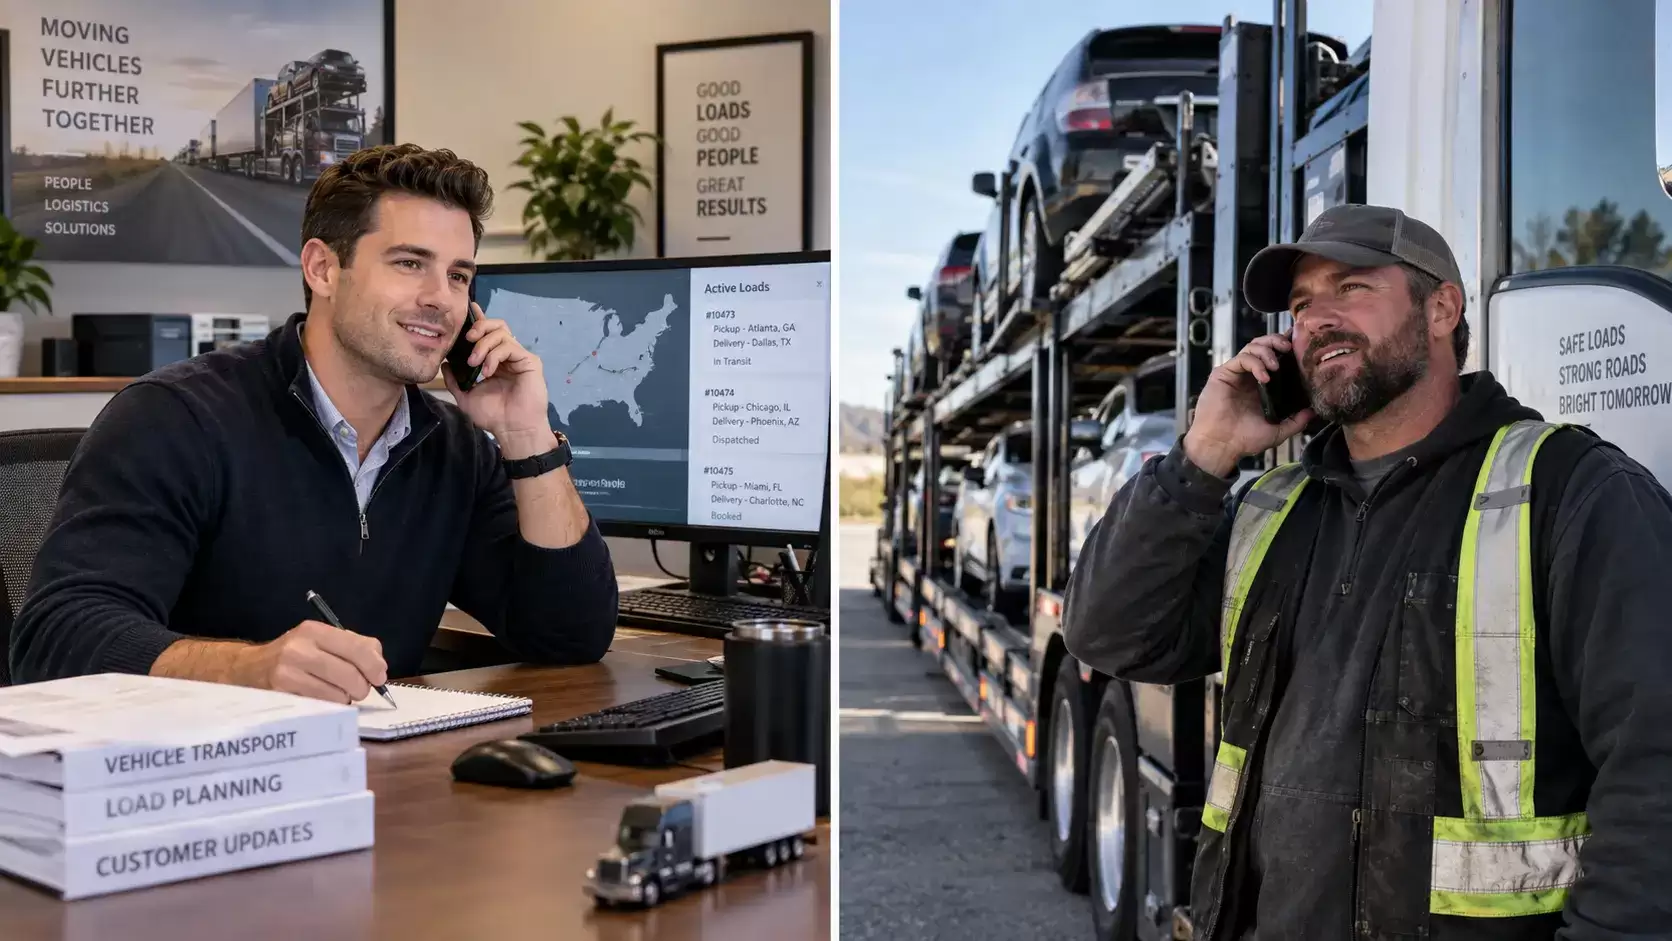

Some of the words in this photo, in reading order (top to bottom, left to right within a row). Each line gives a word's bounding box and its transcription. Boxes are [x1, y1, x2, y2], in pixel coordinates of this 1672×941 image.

[41, 17, 129, 44] MOVING
[41, 48, 142, 75] VEHICLES
[43, 78, 139, 105] FURTHER
[696, 80, 741, 98] GOOD
[696, 101, 751, 121] LOADS
[43, 109, 154, 135] TOGETHER
[696, 127, 741, 143] GOOD
[697, 147, 759, 166] PEOPLE
[44, 176, 92, 191] PEOPLE
[697, 176, 745, 194] GREAT
[45, 198, 109, 213] LOGISTICS
[697, 197, 767, 216] RESULTS
[45, 221, 116, 236] SOLUTIONS
[704, 283, 737, 294] Active
[739, 281, 770, 293] Loads
[705, 310, 736, 319] #10473
[713, 325, 740, 334] Pickup
[782, 323, 796, 332] GA
[713, 339, 745, 348] Delivery
[752, 338, 779, 347] Dallas,
[781, 337, 792, 346] TX
[1559, 332, 1585, 356] SAFE
[1588, 324, 1626, 351] LOADS
[723, 357, 752, 365] Transit
[1559, 360, 1602, 385] STRONG
[1606, 353, 1646, 379] ROADS
[705, 388, 735, 397] #10474
[1559, 392, 1597, 415] BRIGHT
[1601, 382, 1672, 411] TOMORROW
[713, 402, 739, 413] Pickup
[746, 402, 782, 413] Chicago,
[783, 403, 791, 412] IL
[712, 417, 744, 427] Delivery
[751, 417, 786, 427] Phoenix,
[788, 417, 800, 426] AZ
[712, 435, 760, 446] Dispatched
[704, 466, 734, 475] #10475
[711, 480, 738, 491] Pickup
[744, 482, 771, 492] Miami,
[773, 483, 783, 491] FL
[711, 495, 742, 506] Delivery
[749, 496, 790, 507] Charlotte,
[792, 498, 804, 507] NC
[711, 511, 742, 520] Booked
[191, 731, 297, 762] TRANSPORT
[106, 791, 165, 818] LOAD
[173, 774, 283, 807] PLANNING
[96, 839, 217, 878] CUSTOMER
[224, 823, 314, 855] UPDATES
